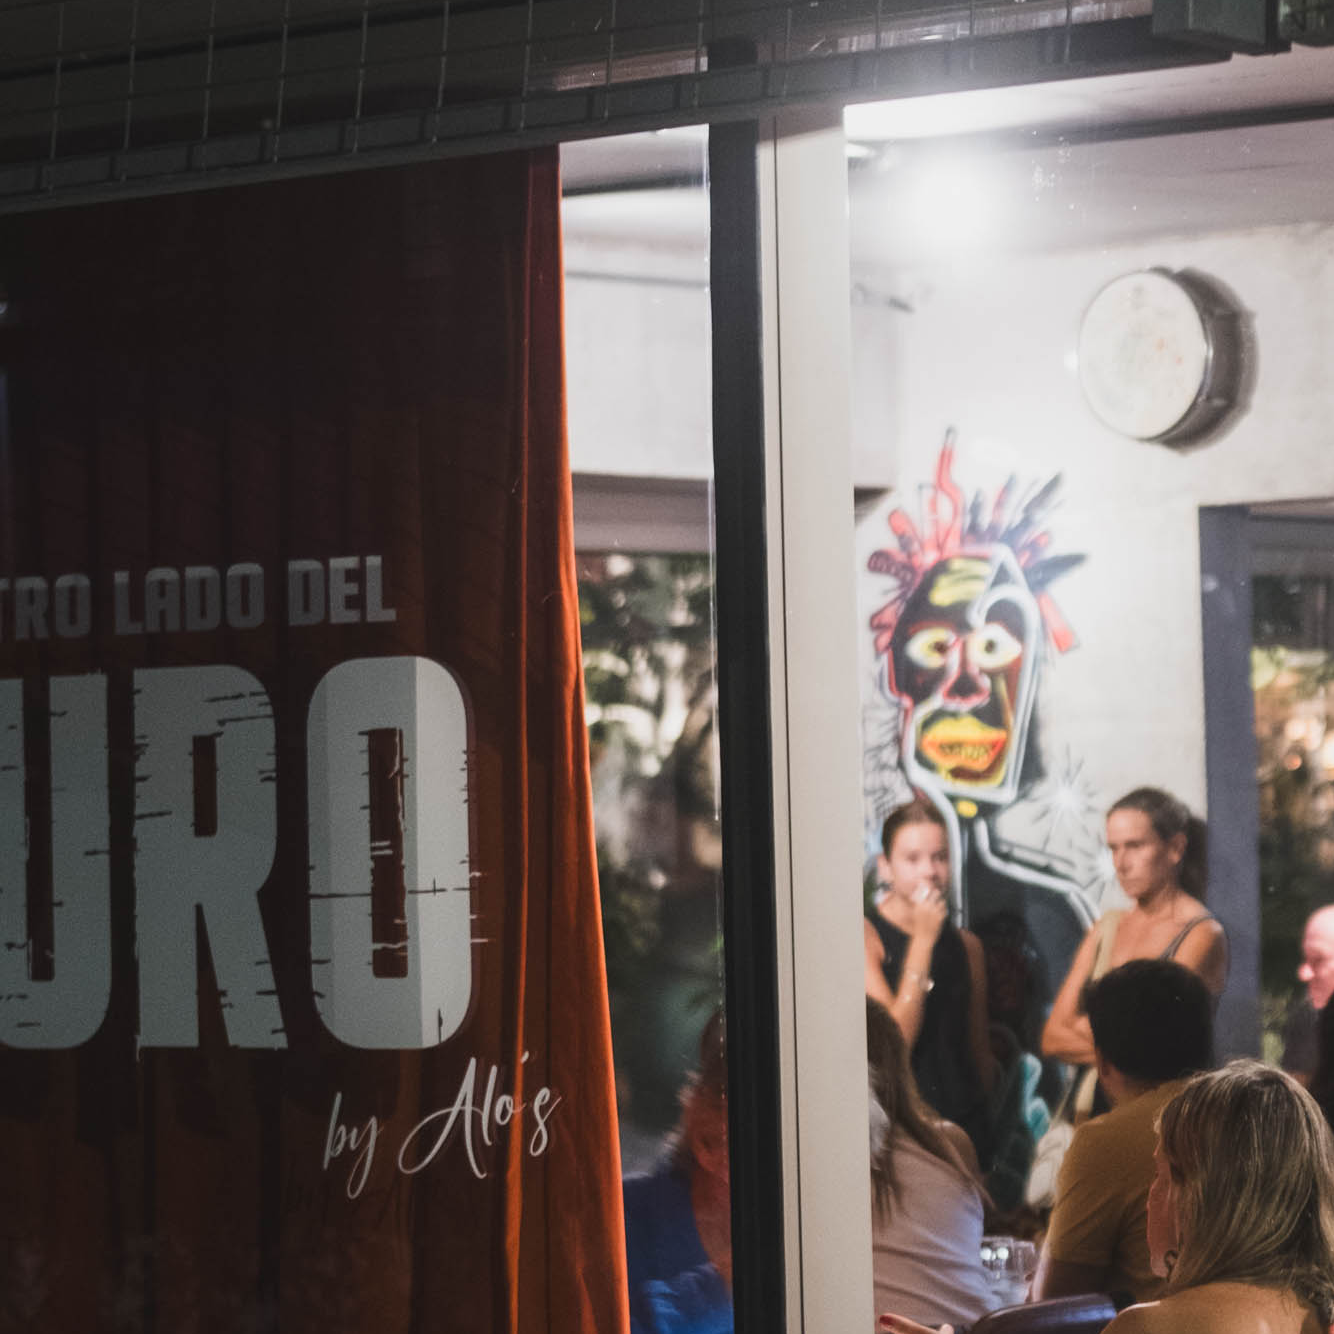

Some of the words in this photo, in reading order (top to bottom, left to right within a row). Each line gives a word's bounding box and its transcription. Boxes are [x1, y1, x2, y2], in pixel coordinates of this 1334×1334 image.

[114, 563, 265, 635] LADO
[288, 555, 397, 626] DEL
[0, 656, 472, 1049] URO
[323, 1092, 384, 1199] by
